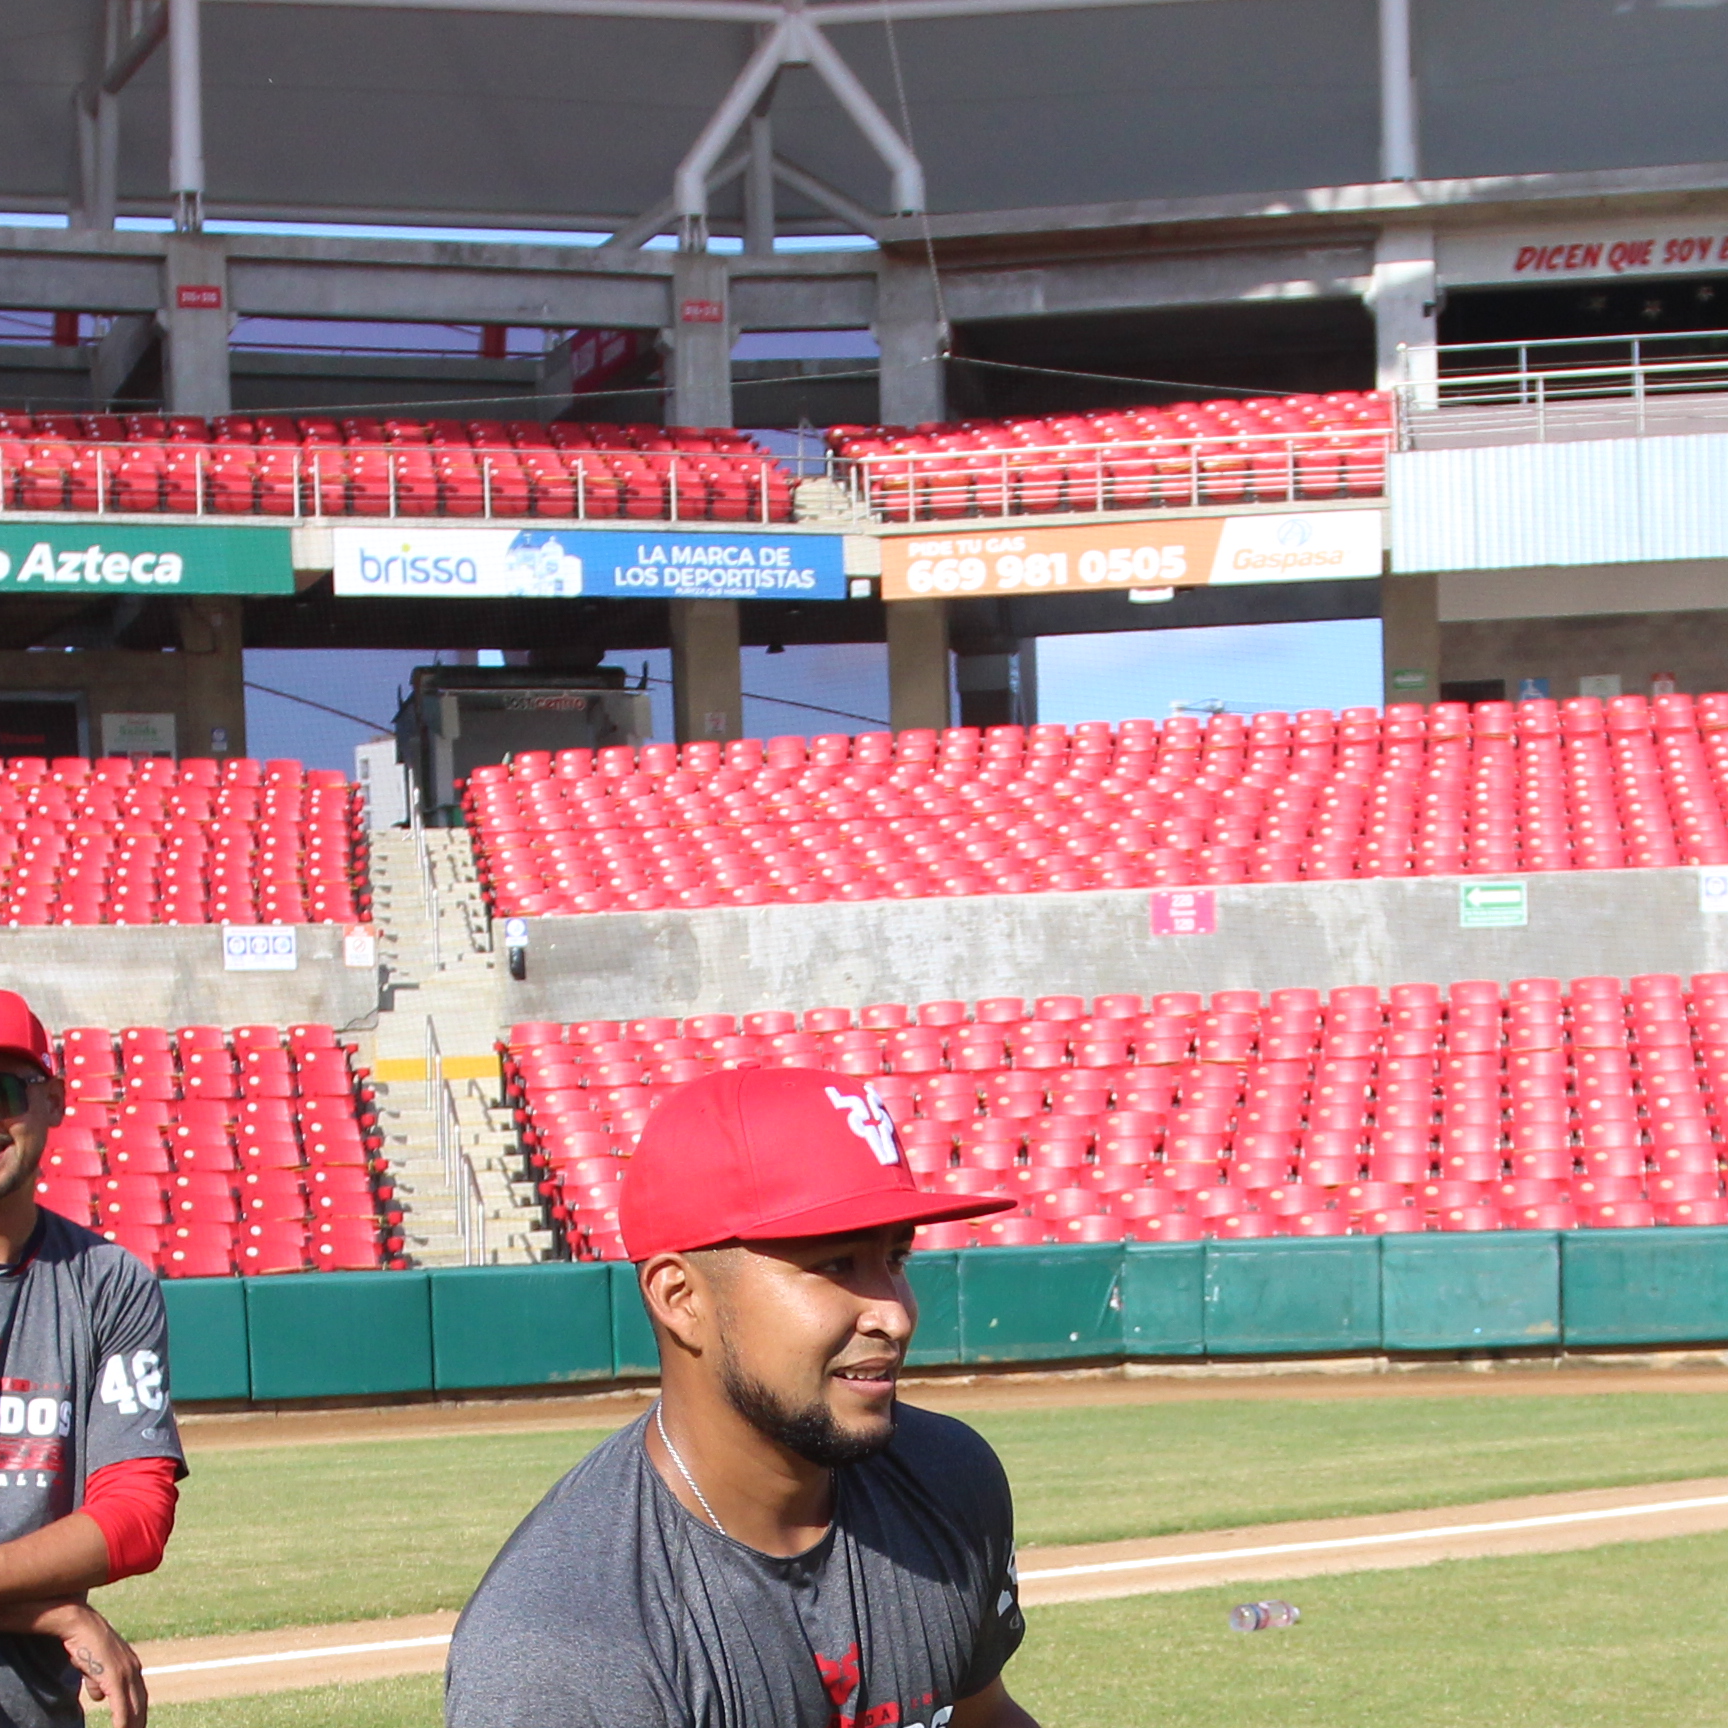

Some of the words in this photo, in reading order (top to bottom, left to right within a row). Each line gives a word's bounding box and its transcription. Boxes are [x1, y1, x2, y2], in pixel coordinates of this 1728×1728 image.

[1513, 242, 1603, 272] DICEN
[1606, 239, 1657, 273] QUE
[1663, 236, 1714, 264] SOY
[637, 545, 668, 565] LA
[671, 545, 756, 567] MARCA
[758, 547, 792, 567] DE
[907, 541, 953, 558] PIDE
[955, 539, 983, 555] TU
[985, 536, 1027, 553] GAS
[1232, 547, 1345, 571] Gaspasa
[16, 542, 184, 584] Azteca
[359, 542, 478, 584] brissa
[614, 566, 660, 587] LOS
[663, 567, 817, 589] DEPORTISTAS
[906, 557, 988, 593] 669
[994, 552, 1069, 589] 981
[1077, 545, 1188, 584] 0505
